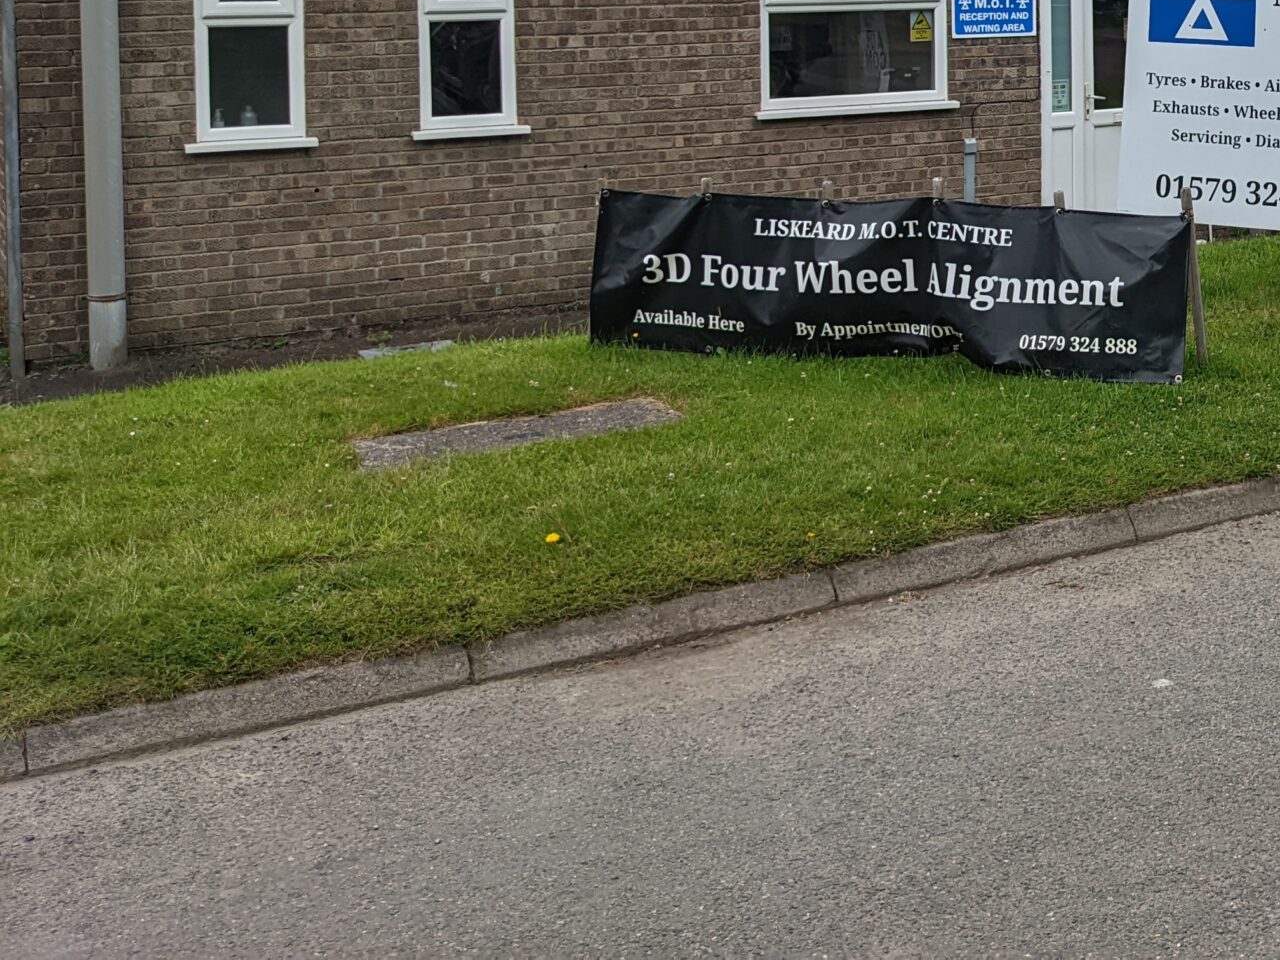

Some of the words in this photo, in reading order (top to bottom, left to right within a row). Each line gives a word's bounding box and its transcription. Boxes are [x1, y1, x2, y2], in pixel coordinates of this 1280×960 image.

[960, 12, 1009, 21] RECEPTION
[1010, 12, 1029, 20] AND
[963, 24, 1000, 33] WAITING
[1001, 24, 1026, 32] AREA
[1146, 71, 1187, 89] Tyres
[1200, 75, 1251, 91] Brakes
[1152, 100, 1220, 117] Exhausts
[1234, 104, 1280, 121] Wheel
[1171, 128, 1242, 149] Servicing
[1155, 174, 1237, 203] 01579
[754, 218, 855, 242] LISKEARD
[858, 219, 923, 242] M.O.T.
[927, 220, 1014, 248] CENTRE
[641, 252, 691, 285] 3D
[700, 253, 787, 292] Four
[795, 258, 918, 296] Wheel
[927, 261, 1124, 312] Alignment
[633, 308, 705, 330] Available
[708, 313, 745, 333] Here
[795, 321, 817, 340] By
[1018, 333, 1065, 353] 01579
[1068, 335, 1101, 355] 324
[1105, 337, 1138, 356] 888
